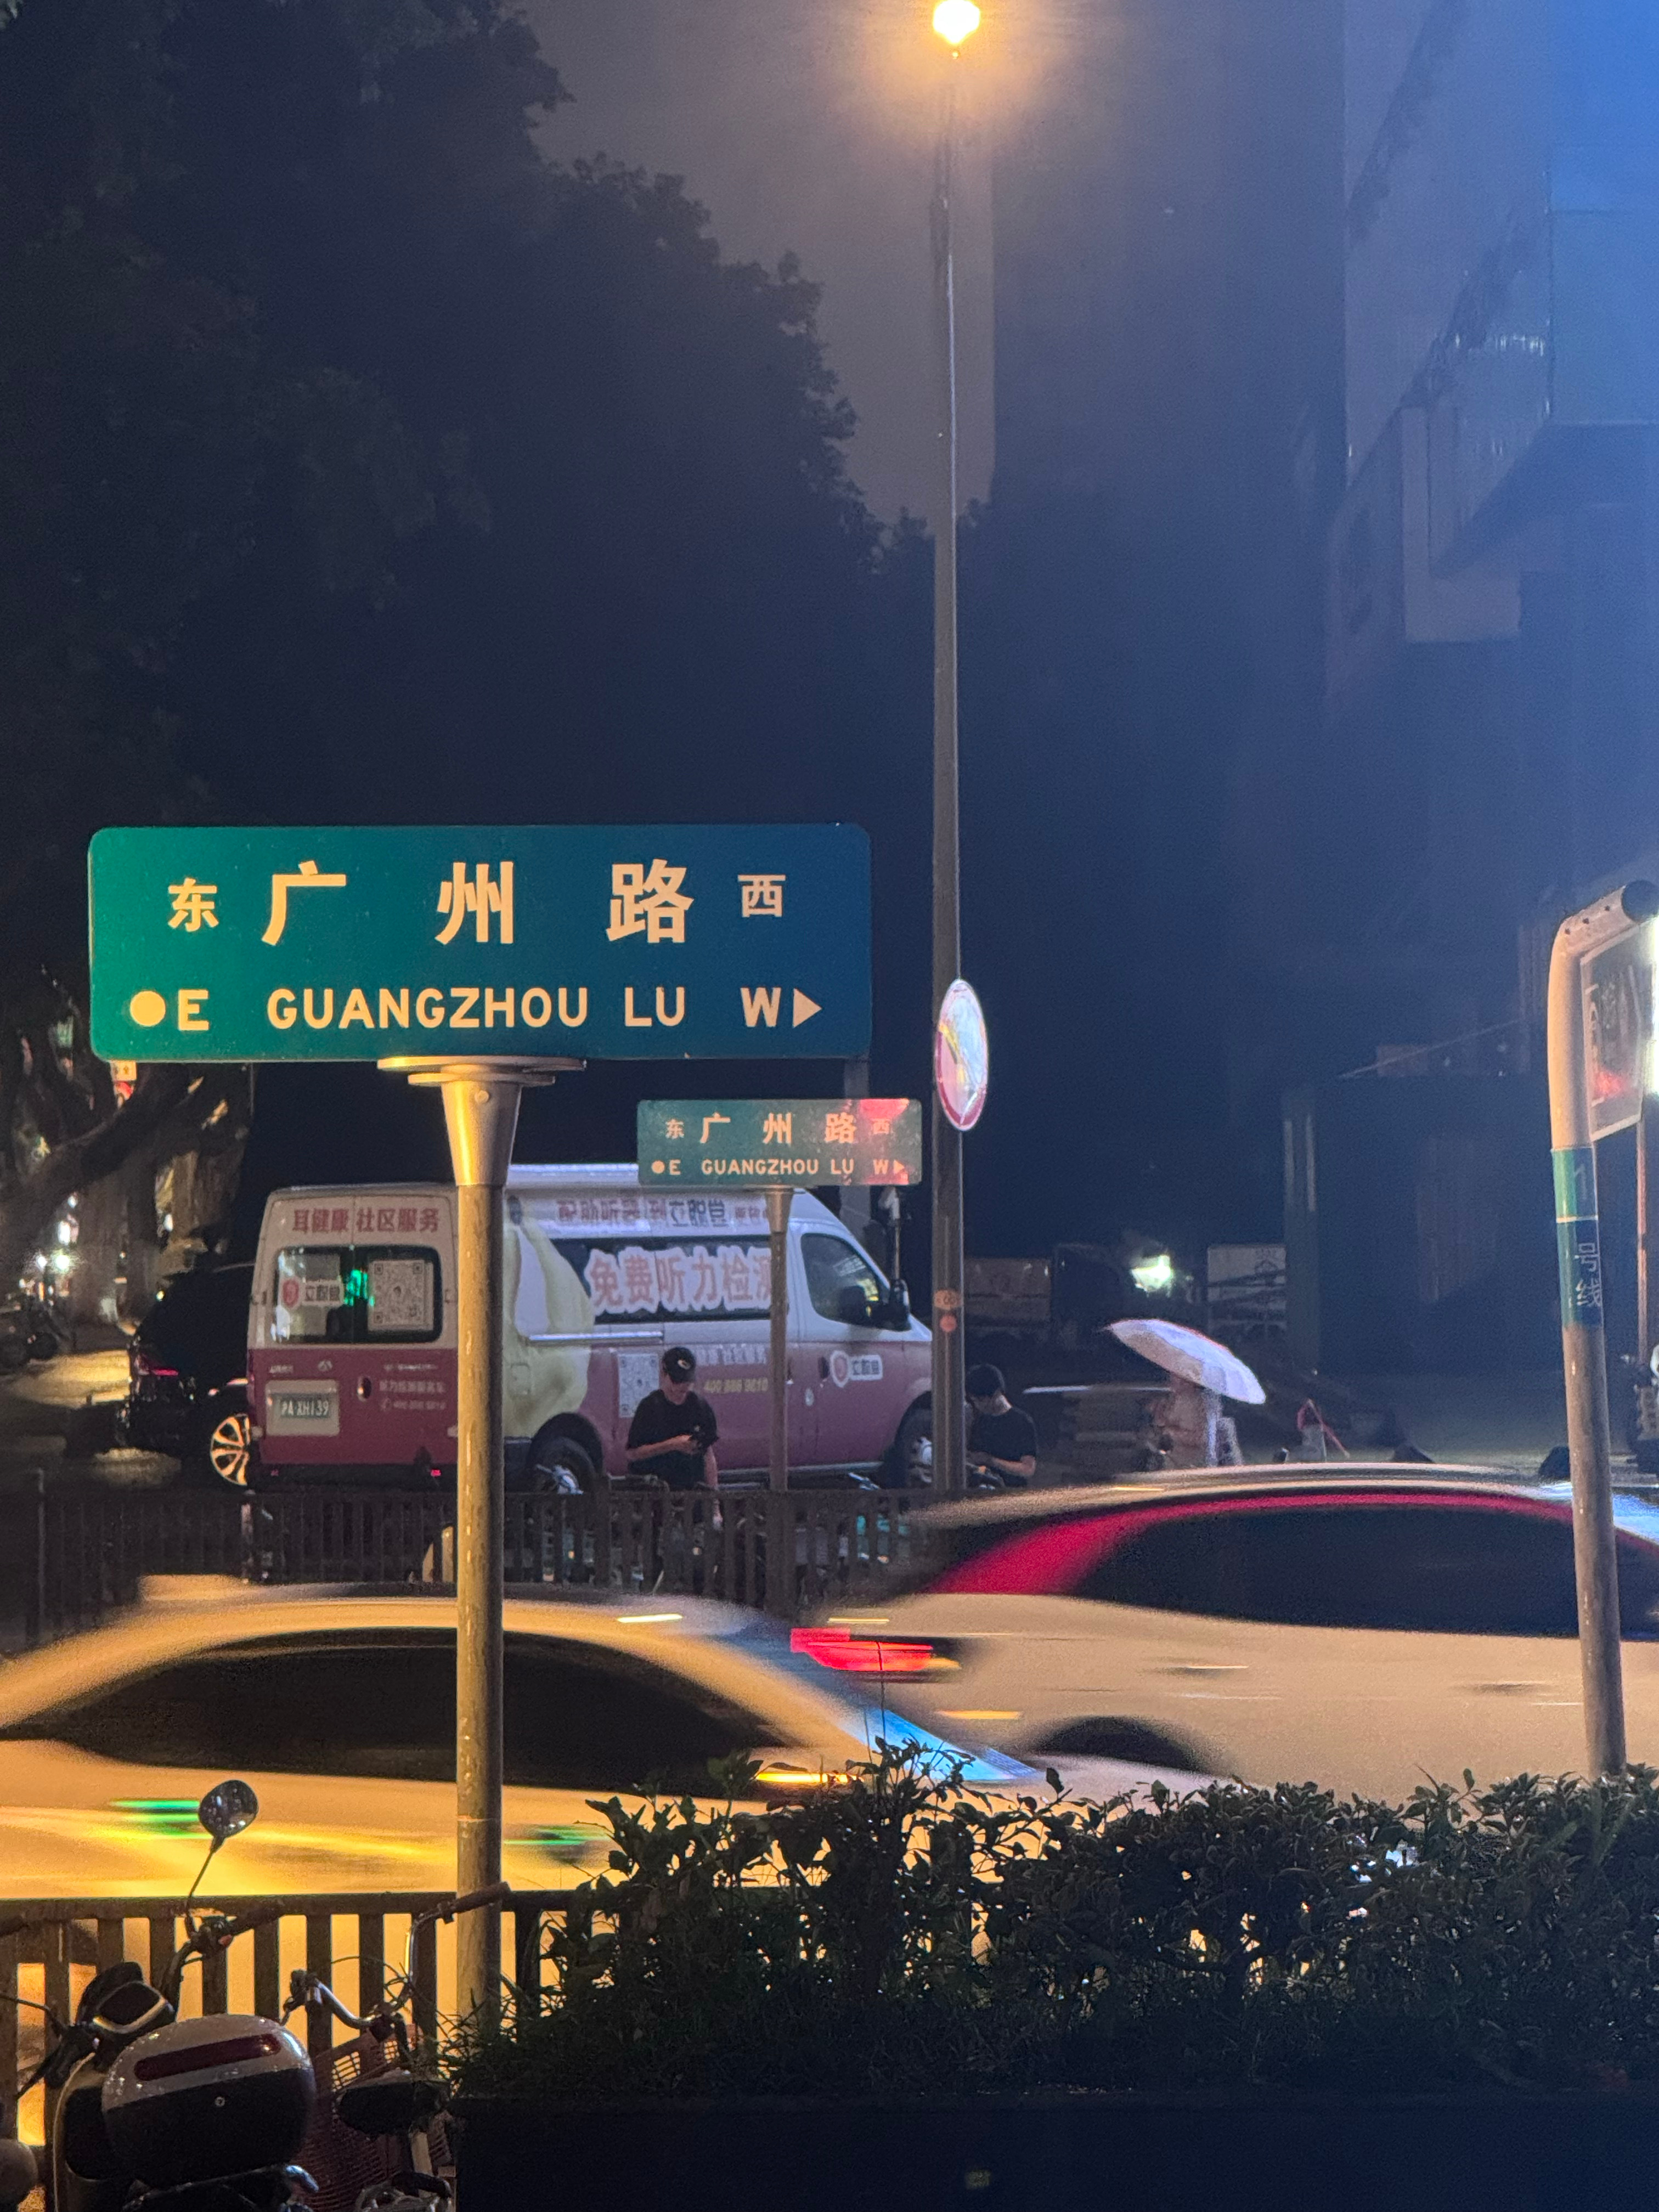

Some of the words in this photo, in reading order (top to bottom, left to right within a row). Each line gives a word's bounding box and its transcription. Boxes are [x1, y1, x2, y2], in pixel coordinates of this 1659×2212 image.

[168, 878, 219, 932] 东
[261, 858, 695, 946] 广州路
[737, 874, 786, 918] 西
[178, 990, 209, 1031] E
[267, 987, 588, 1029] GUANGZHOU
[624, 987, 686, 1028] LU
[741, 987, 782, 1028] W
[665, 1118, 685, 1139] 东
[699, 1111, 856, 1144] 广州路
[872, 1118, 891, 1135] 西
[669, 1159, 681, 1175] E
[701, 1158, 819, 1175] GUANGZHOU
[830, 1158, 854, 1175] LU
[872, 1159, 889, 1174] W
[590, 1254, 771, 1307] 免费听力检测
[1574, 1242, 1601, 1307] 号线
